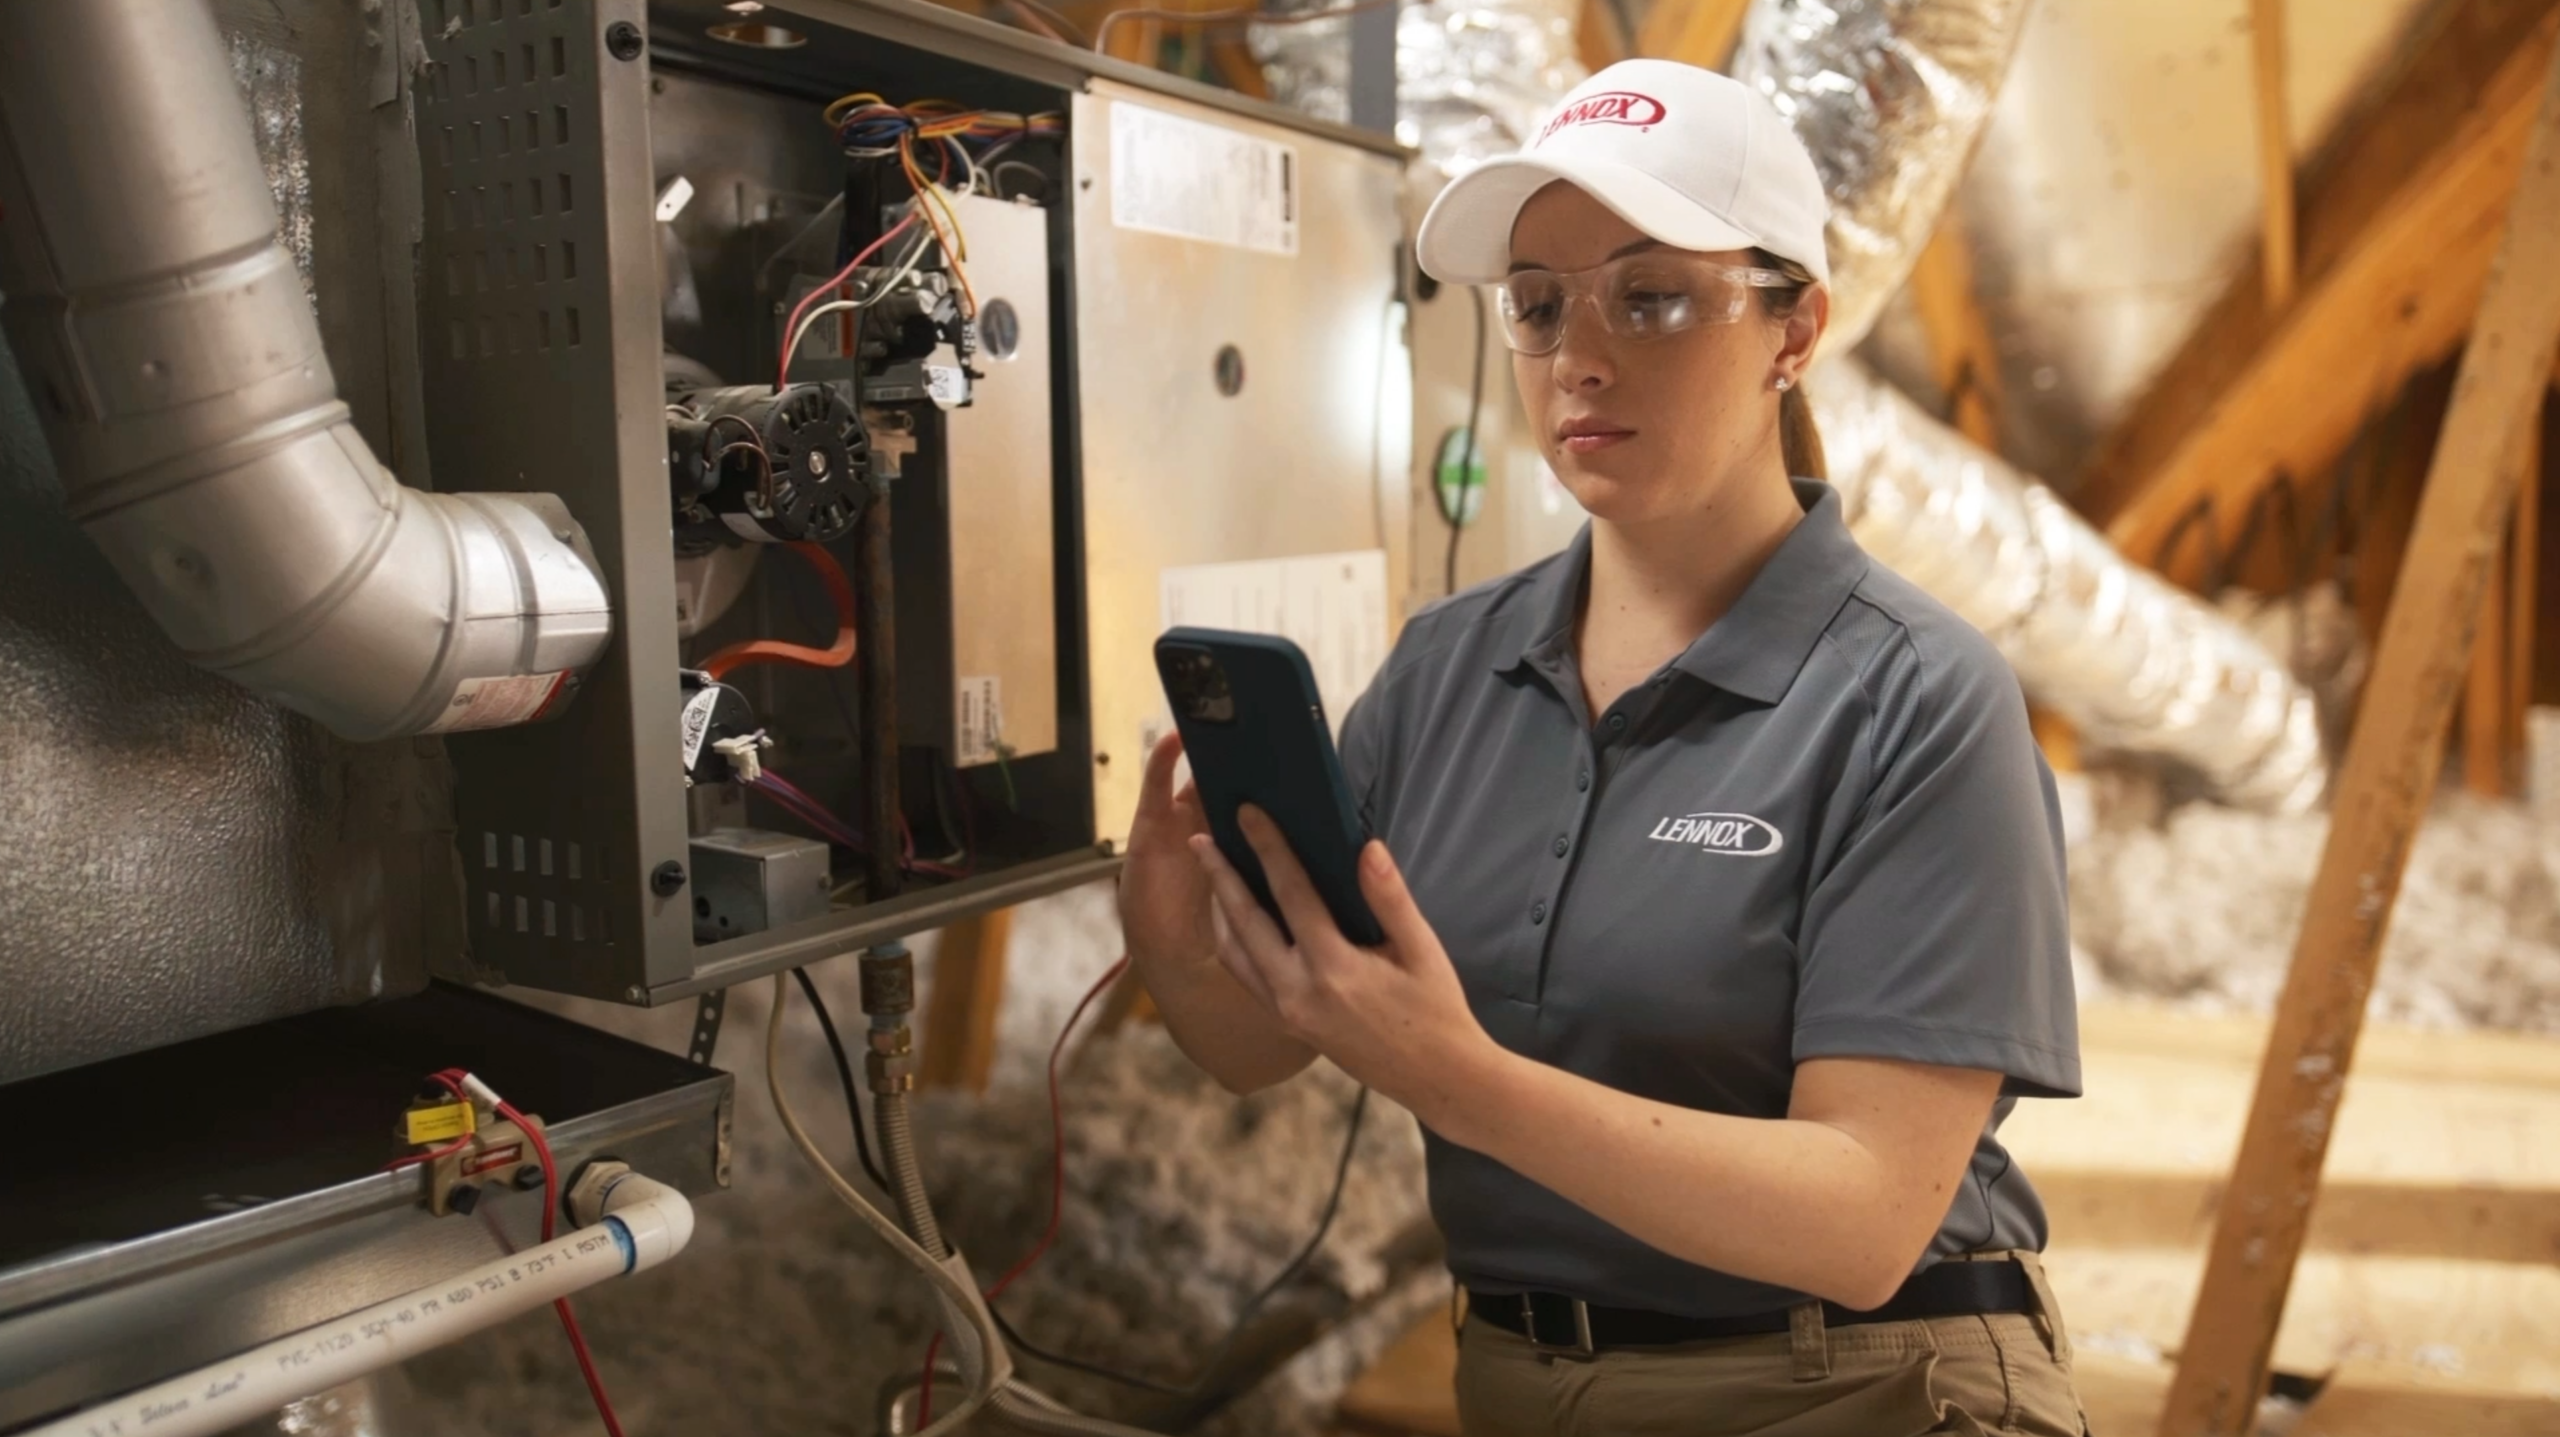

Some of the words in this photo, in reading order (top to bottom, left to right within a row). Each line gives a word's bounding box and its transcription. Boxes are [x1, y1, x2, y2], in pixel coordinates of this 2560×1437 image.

[1534, 98, 1640, 149] LENNOX
[1648, 817, 1755, 848] LENNOX
[277, 1331, 355, 1371] PVC-1120
[359, 1309, 416, 1340] SCH-40
[419, 1299, 442, 1317] PR
[475, 1274, 506, 1294] PSI
[576, 1233, 611, 1255] ASTM
